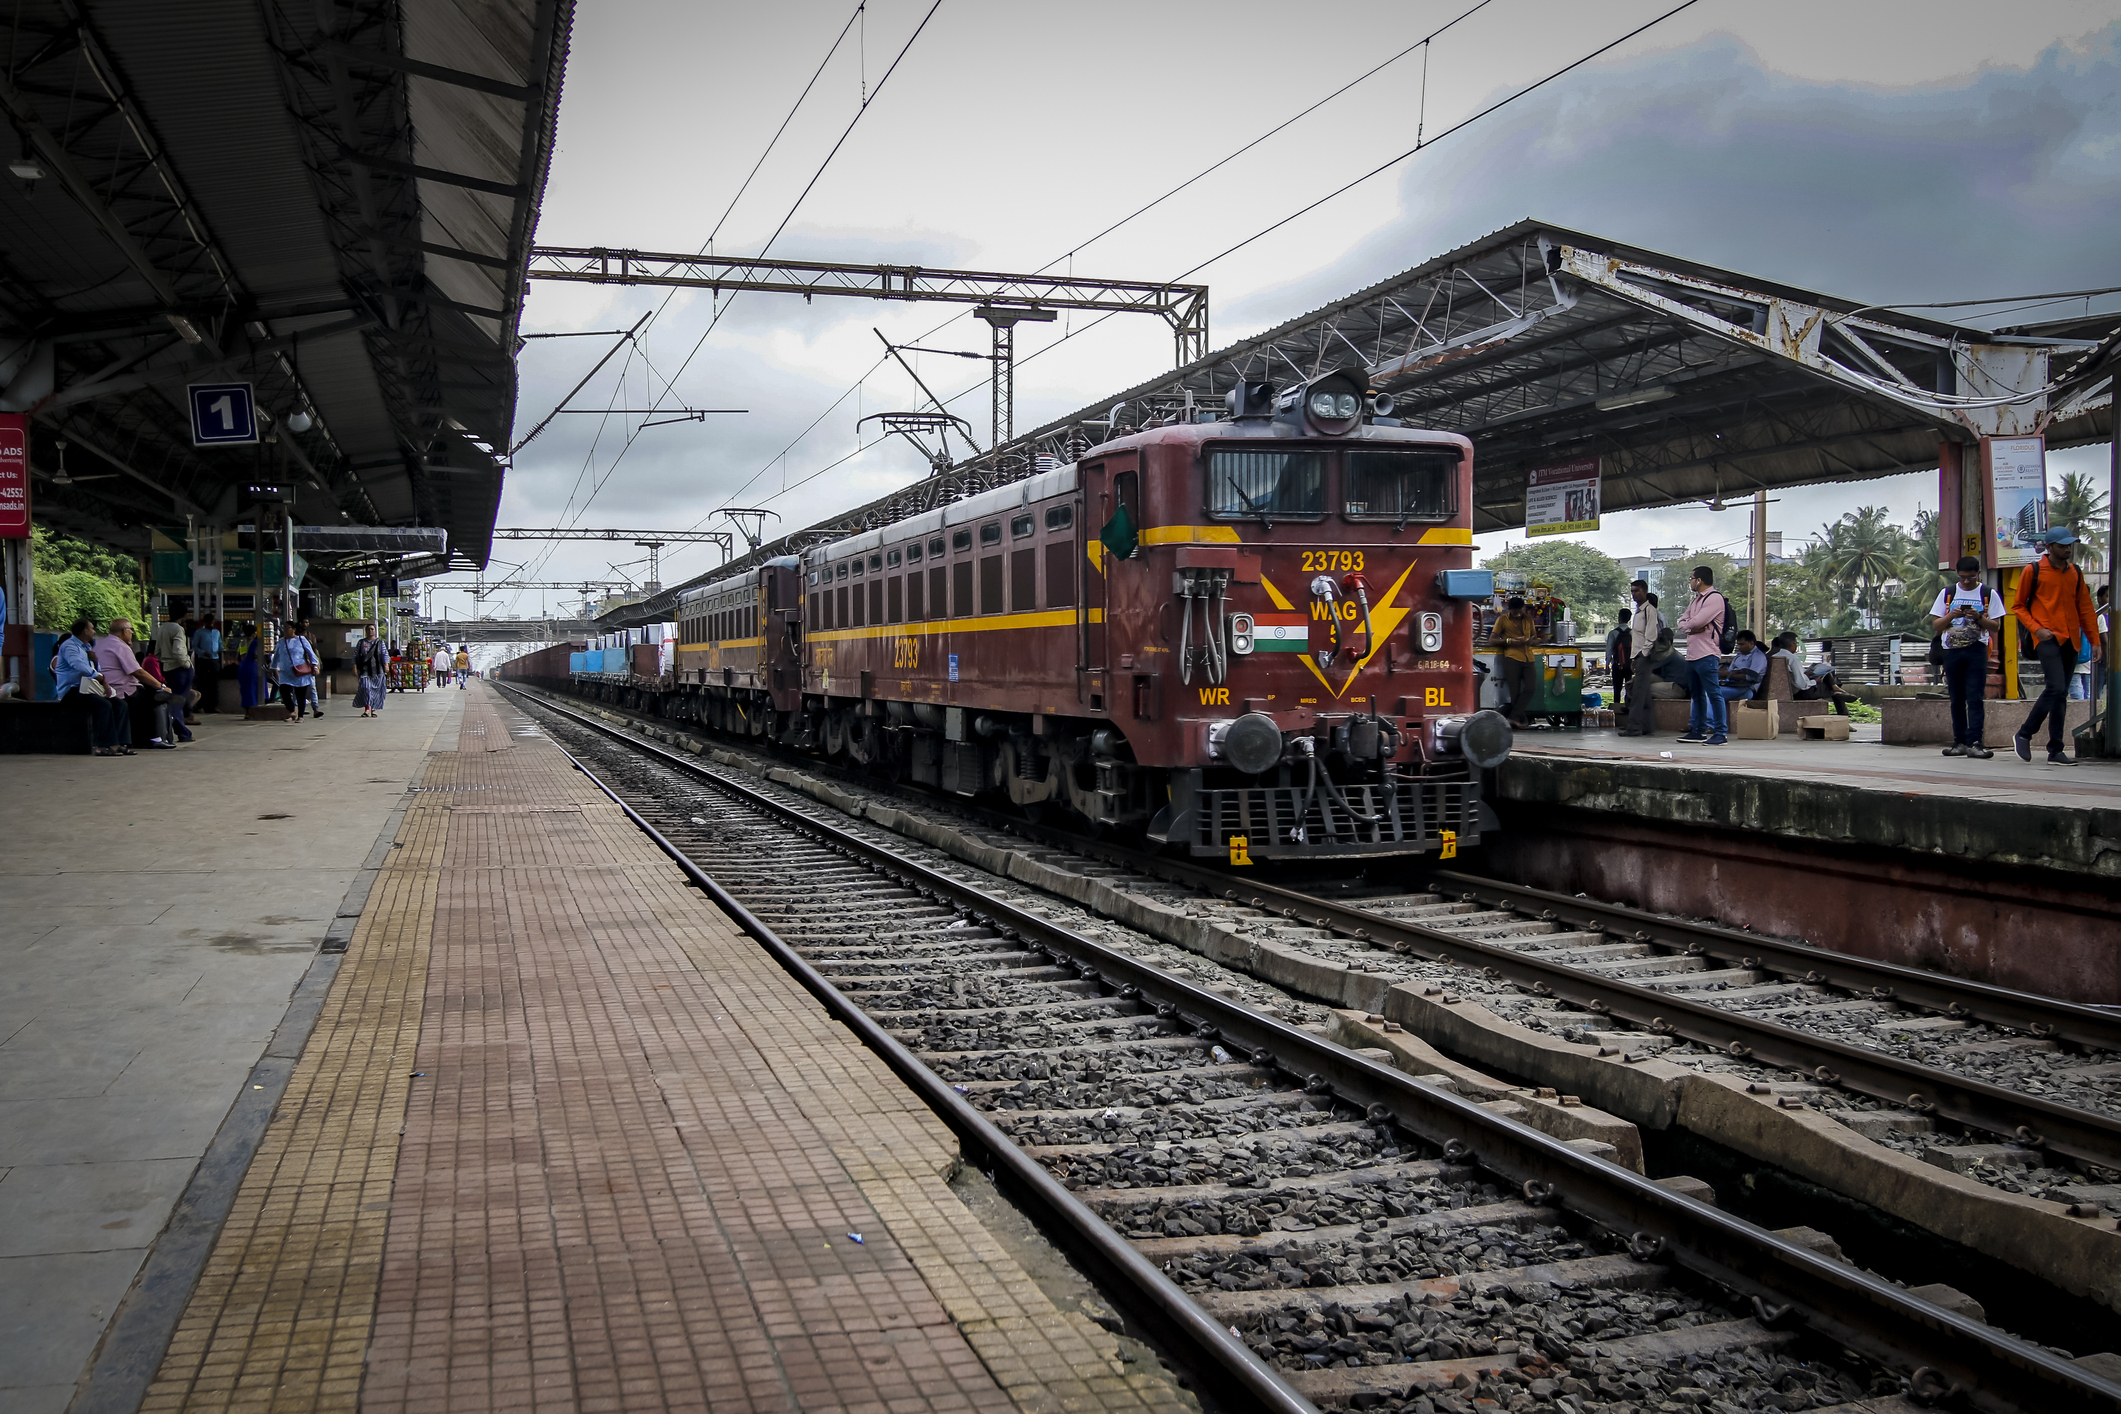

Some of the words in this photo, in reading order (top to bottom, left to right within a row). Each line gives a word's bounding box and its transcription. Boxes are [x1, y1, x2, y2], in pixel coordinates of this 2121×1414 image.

[210, 395, 234, 430] 1
[3, 447, 22, 456] ADS
[1572, 462, 1594, 472] University
[1967, 537, 1976, 552] 15
[1301, 550, 1365, 572] 23793
[1310, 600, 1357, 620] WAG
[894, 638, 918, 668] 23793
[1199, 688, 1230, 706] WR
[1425, 687, 1451, 706] BL
